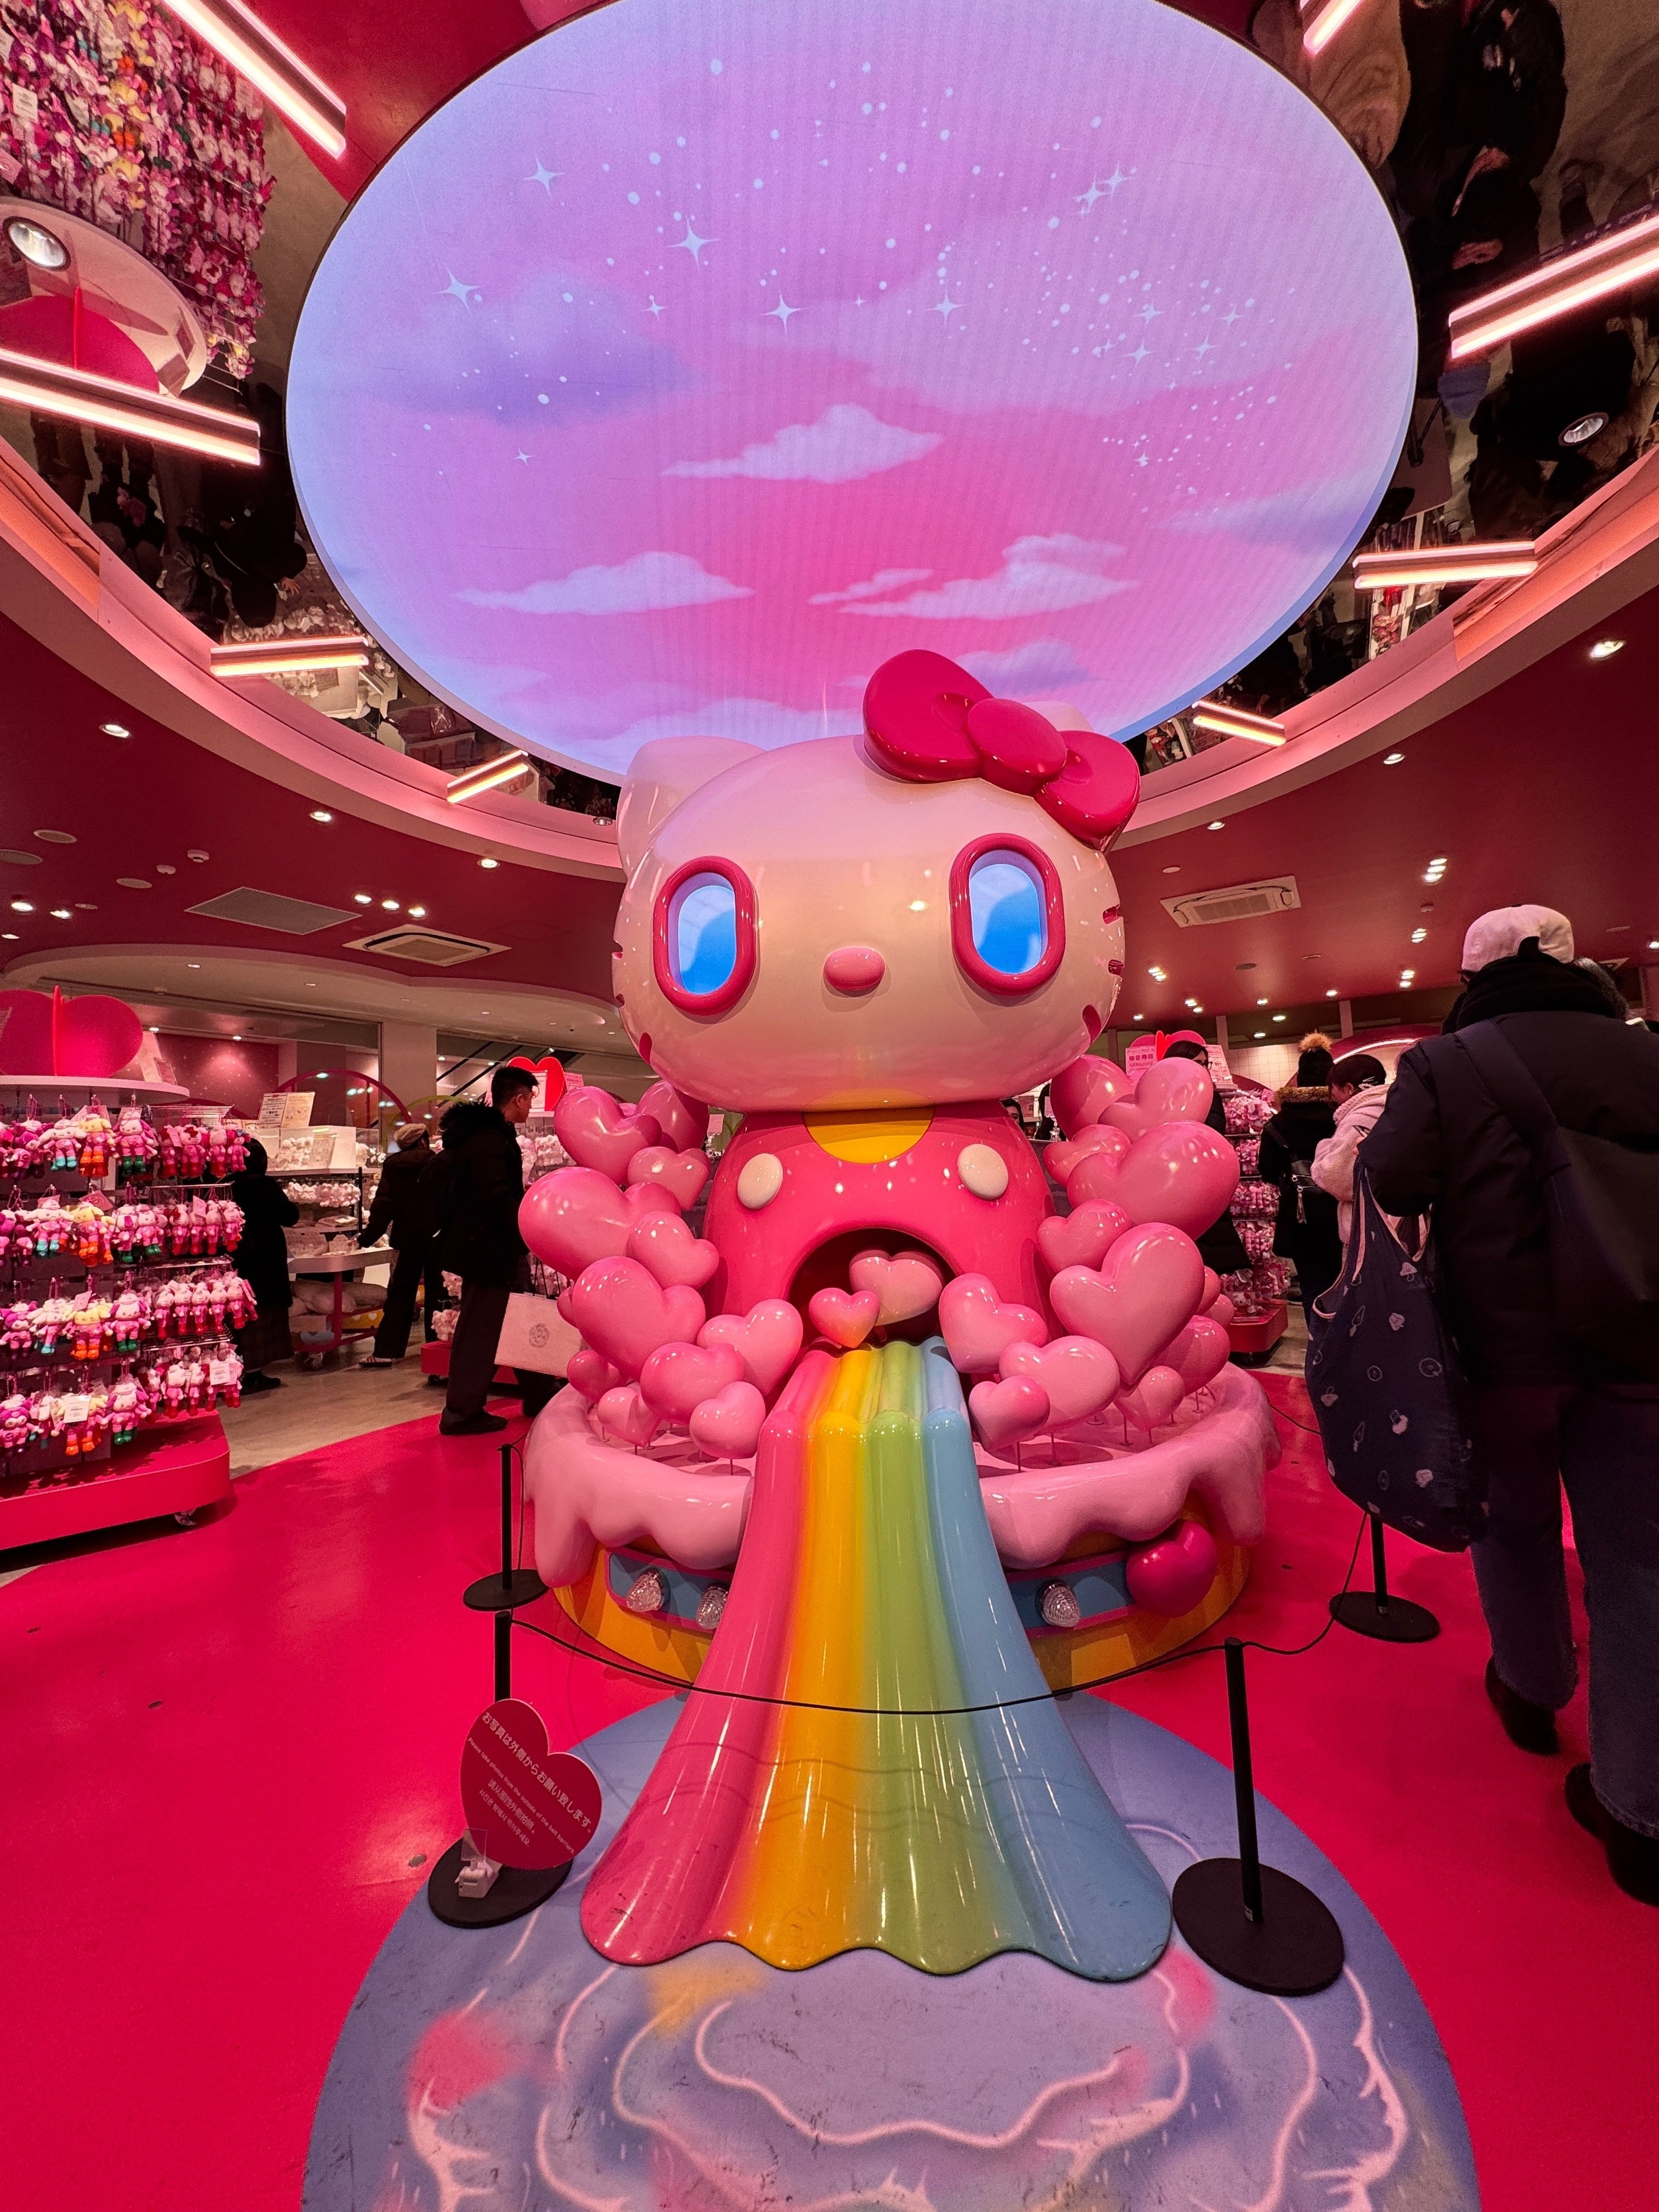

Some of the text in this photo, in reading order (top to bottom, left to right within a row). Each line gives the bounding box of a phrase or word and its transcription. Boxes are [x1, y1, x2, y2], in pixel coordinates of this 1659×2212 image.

[467, 1737, 481, 1753] Please
[481, 1752, 490, 1763] take
[489, 1762, 504, 1779] photos
[504, 1776, 514, 1789] from
[513, 1787, 521, 1797] the
[520, 1796, 536, 1813] outside
[540, 1817, 549, 1827] the
[482, 1712, 592, 1833] お写真は外側からお願い致します。
